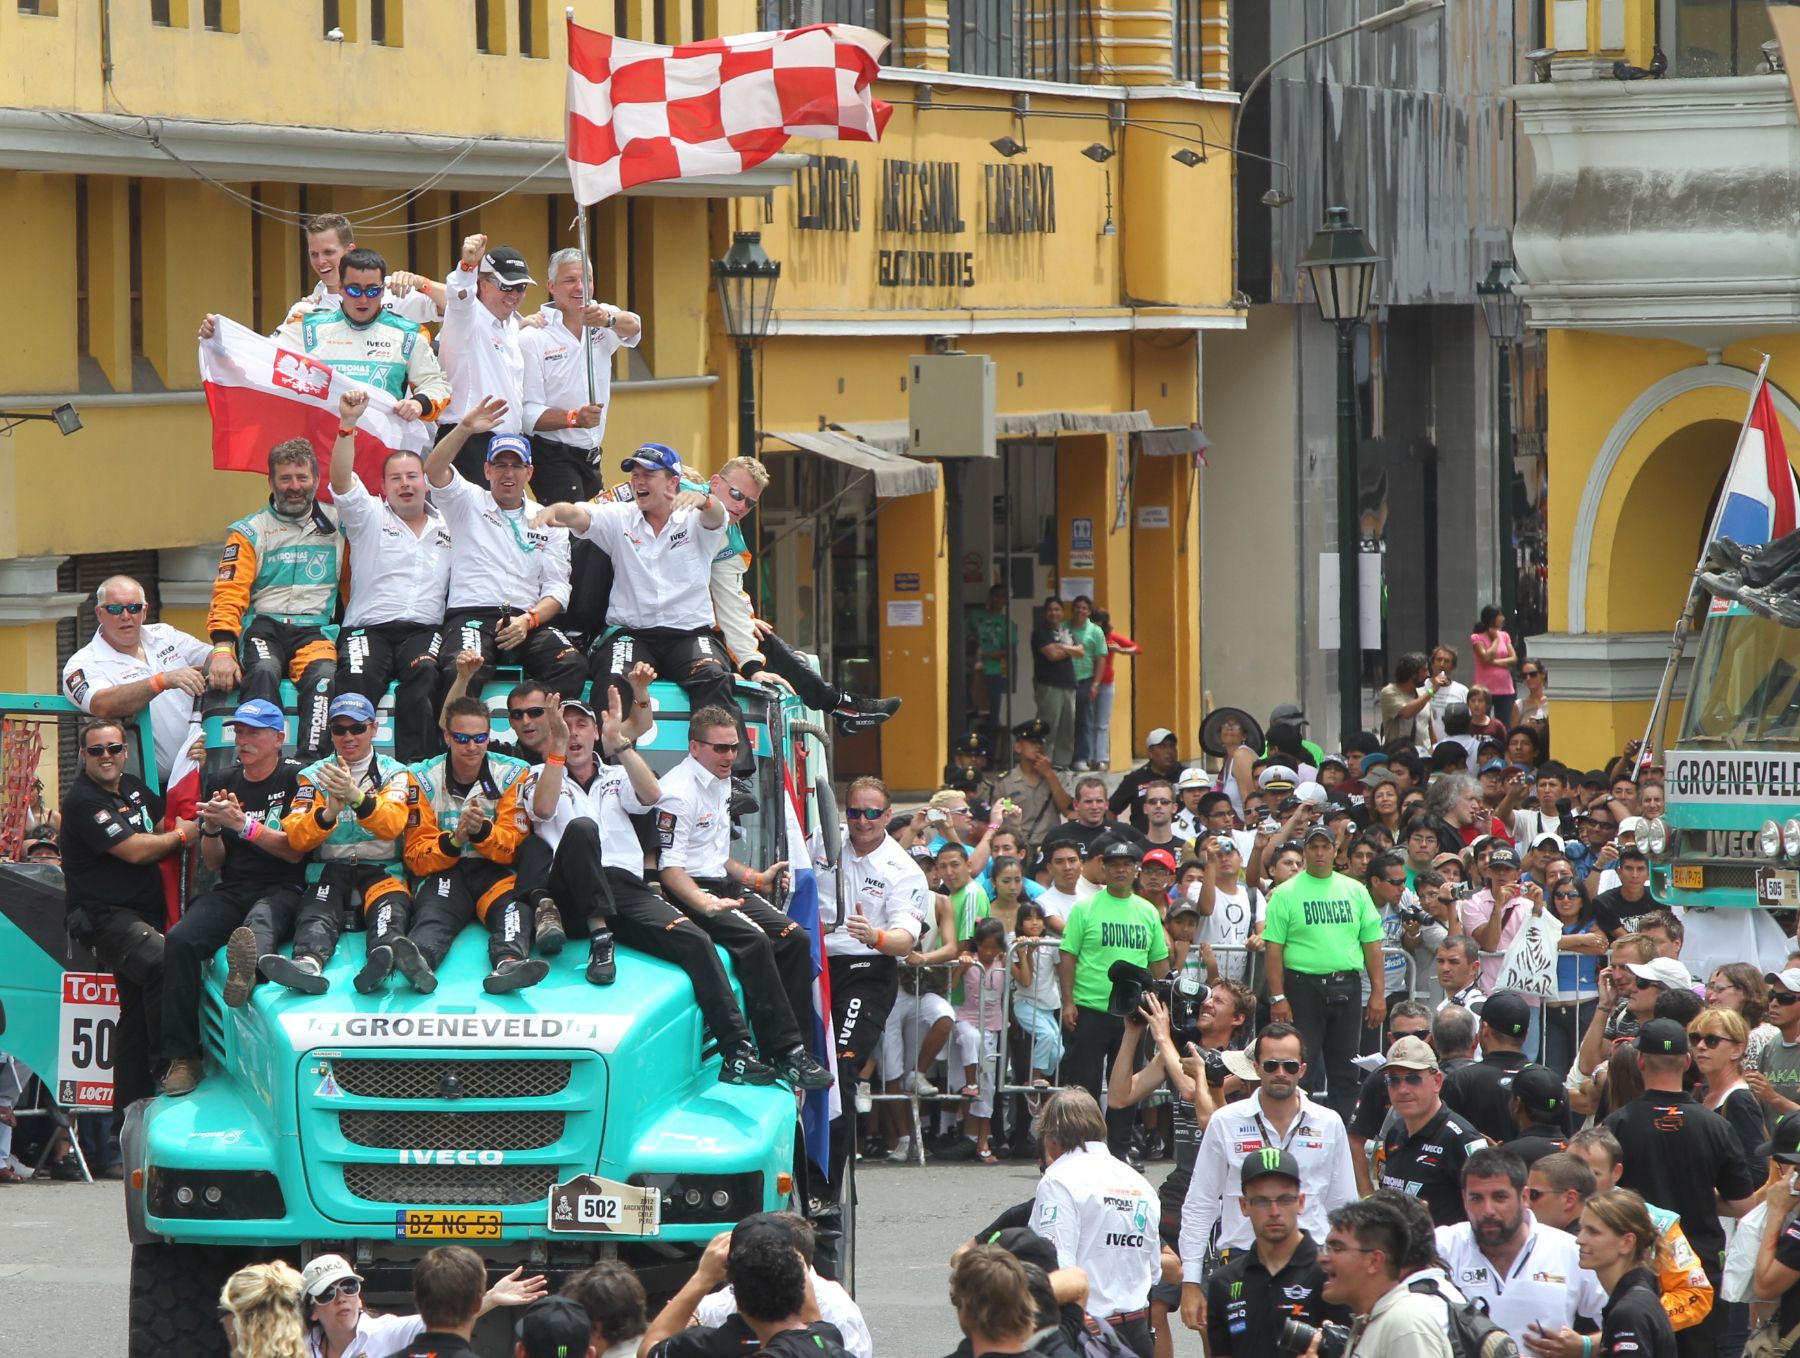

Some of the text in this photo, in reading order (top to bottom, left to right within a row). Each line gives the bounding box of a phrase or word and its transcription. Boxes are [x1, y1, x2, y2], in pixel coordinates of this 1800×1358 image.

[366, 340, 391, 348] IVECO
[308, 695, 325, 751] PETRONAS
[1677, 759, 1800, 797] GROENEVELD
[1768, 881, 1783, 897] 505
[1303, 900, 1354, 925] BOUNCER
[1101, 922, 1148, 950] BOUNCER
[66, 977, 120, 1002] TOT
[1506, 968, 1553, 996] DAKAR
[345, 1018, 563, 1039] GROENEVELD
[837, 997, 862, 1046] IVECO
[399, 1149, 504, 1165] IVECO
[1421, 1143, 1444, 1155] IVECO
[584, 1198, 617, 1218] 502
[1105, 1232, 1144, 1248] IVECO
